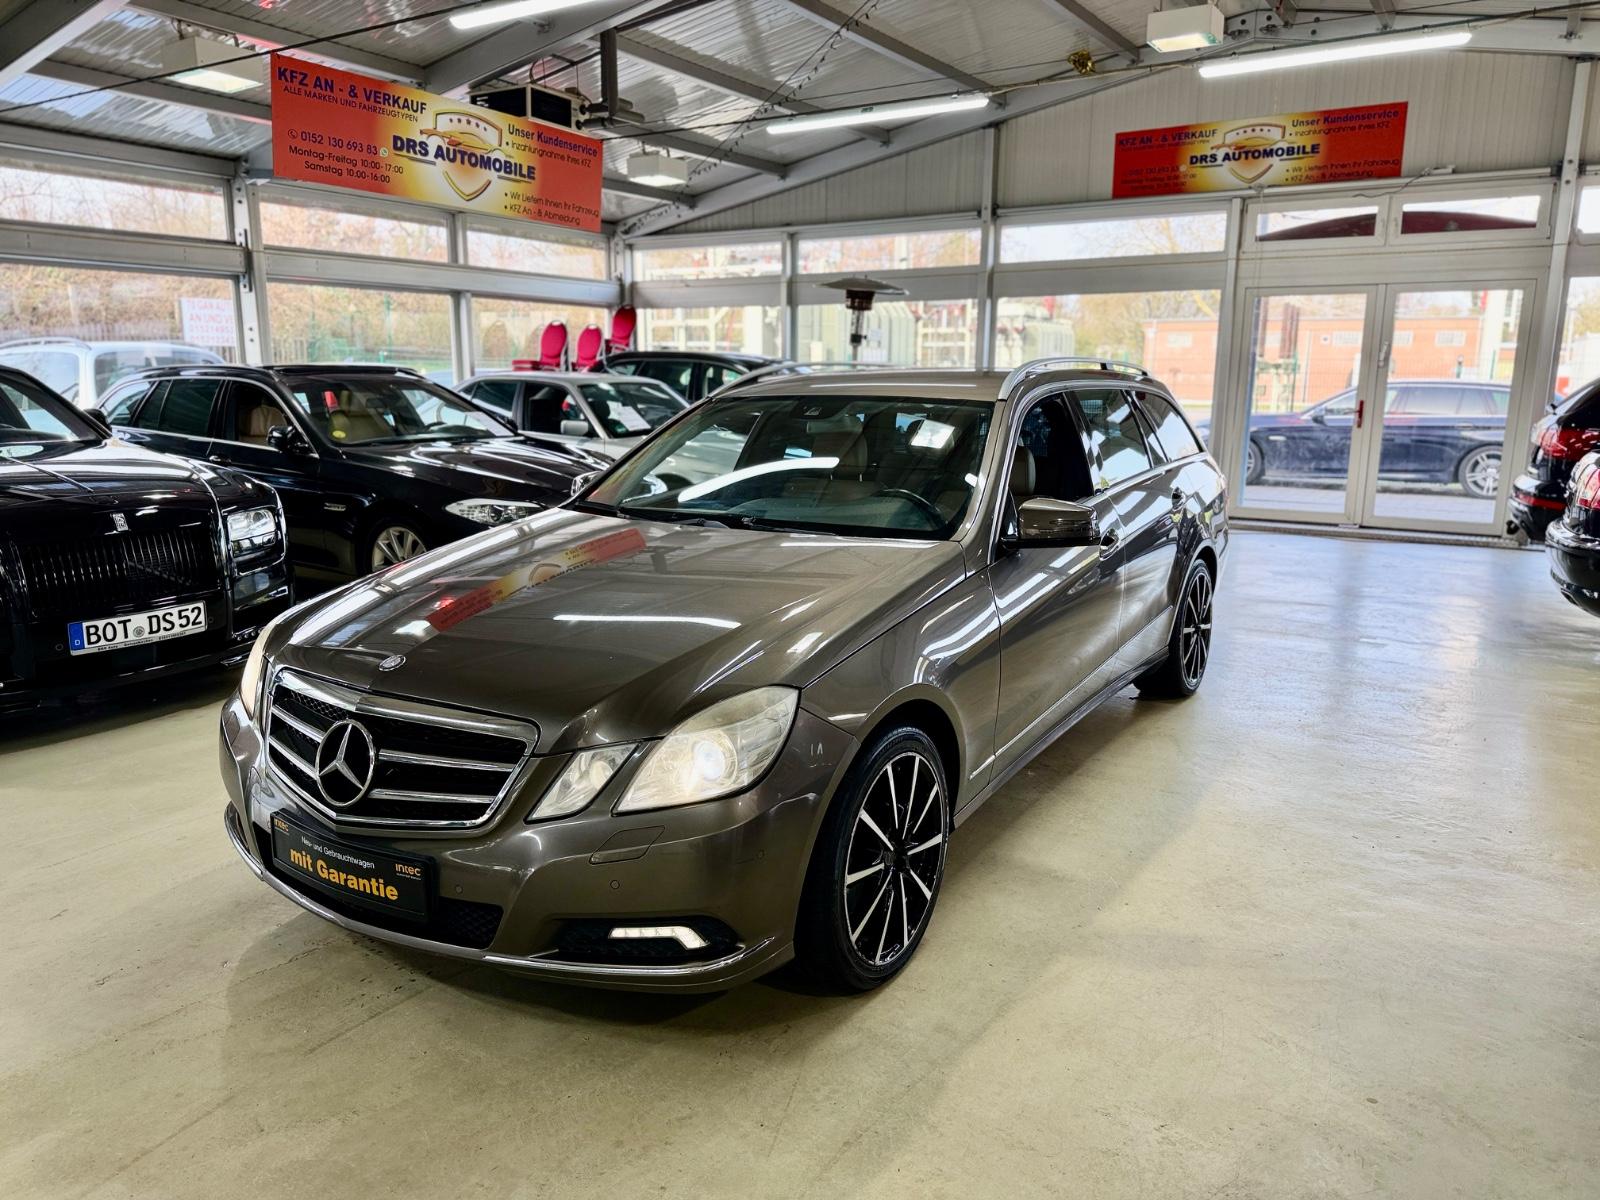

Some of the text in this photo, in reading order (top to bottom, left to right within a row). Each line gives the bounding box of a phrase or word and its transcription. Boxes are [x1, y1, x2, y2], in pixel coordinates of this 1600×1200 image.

[278, 66, 308, 87] KFZ
[313, 76, 334, 93] AN
[348, 84, 358, 98] &
[363, 87, 427, 114] VERKAUF
[283, 85, 419, 122] ALLE MARKEN UND FAHRZEUGTYPEN
[1292, 109, 1400, 128] Unser Kundenservice
[300, 131, 378, 156] 0152 130 693 83
[508, 123, 598, 158] Unser Kundenservice
[1172, 129, 1218, 142] VERKAUF
[288, 145, 358, 168] Montag-Freitag
[304, 160, 343, 177] Samstag
[392, 134, 537, 181] DRS AUTOMOBILE
[1189, 153, 1218, 166] DRS
[1222, 143, 1321, 163] AUTOMOBILE
[85, 618, 132, 646] BOT
[313, 842, 323, 854] und
[323, 846, 376, 870] Gebrauchtwagen
[290, 848, 399, 901] mit Garantie
